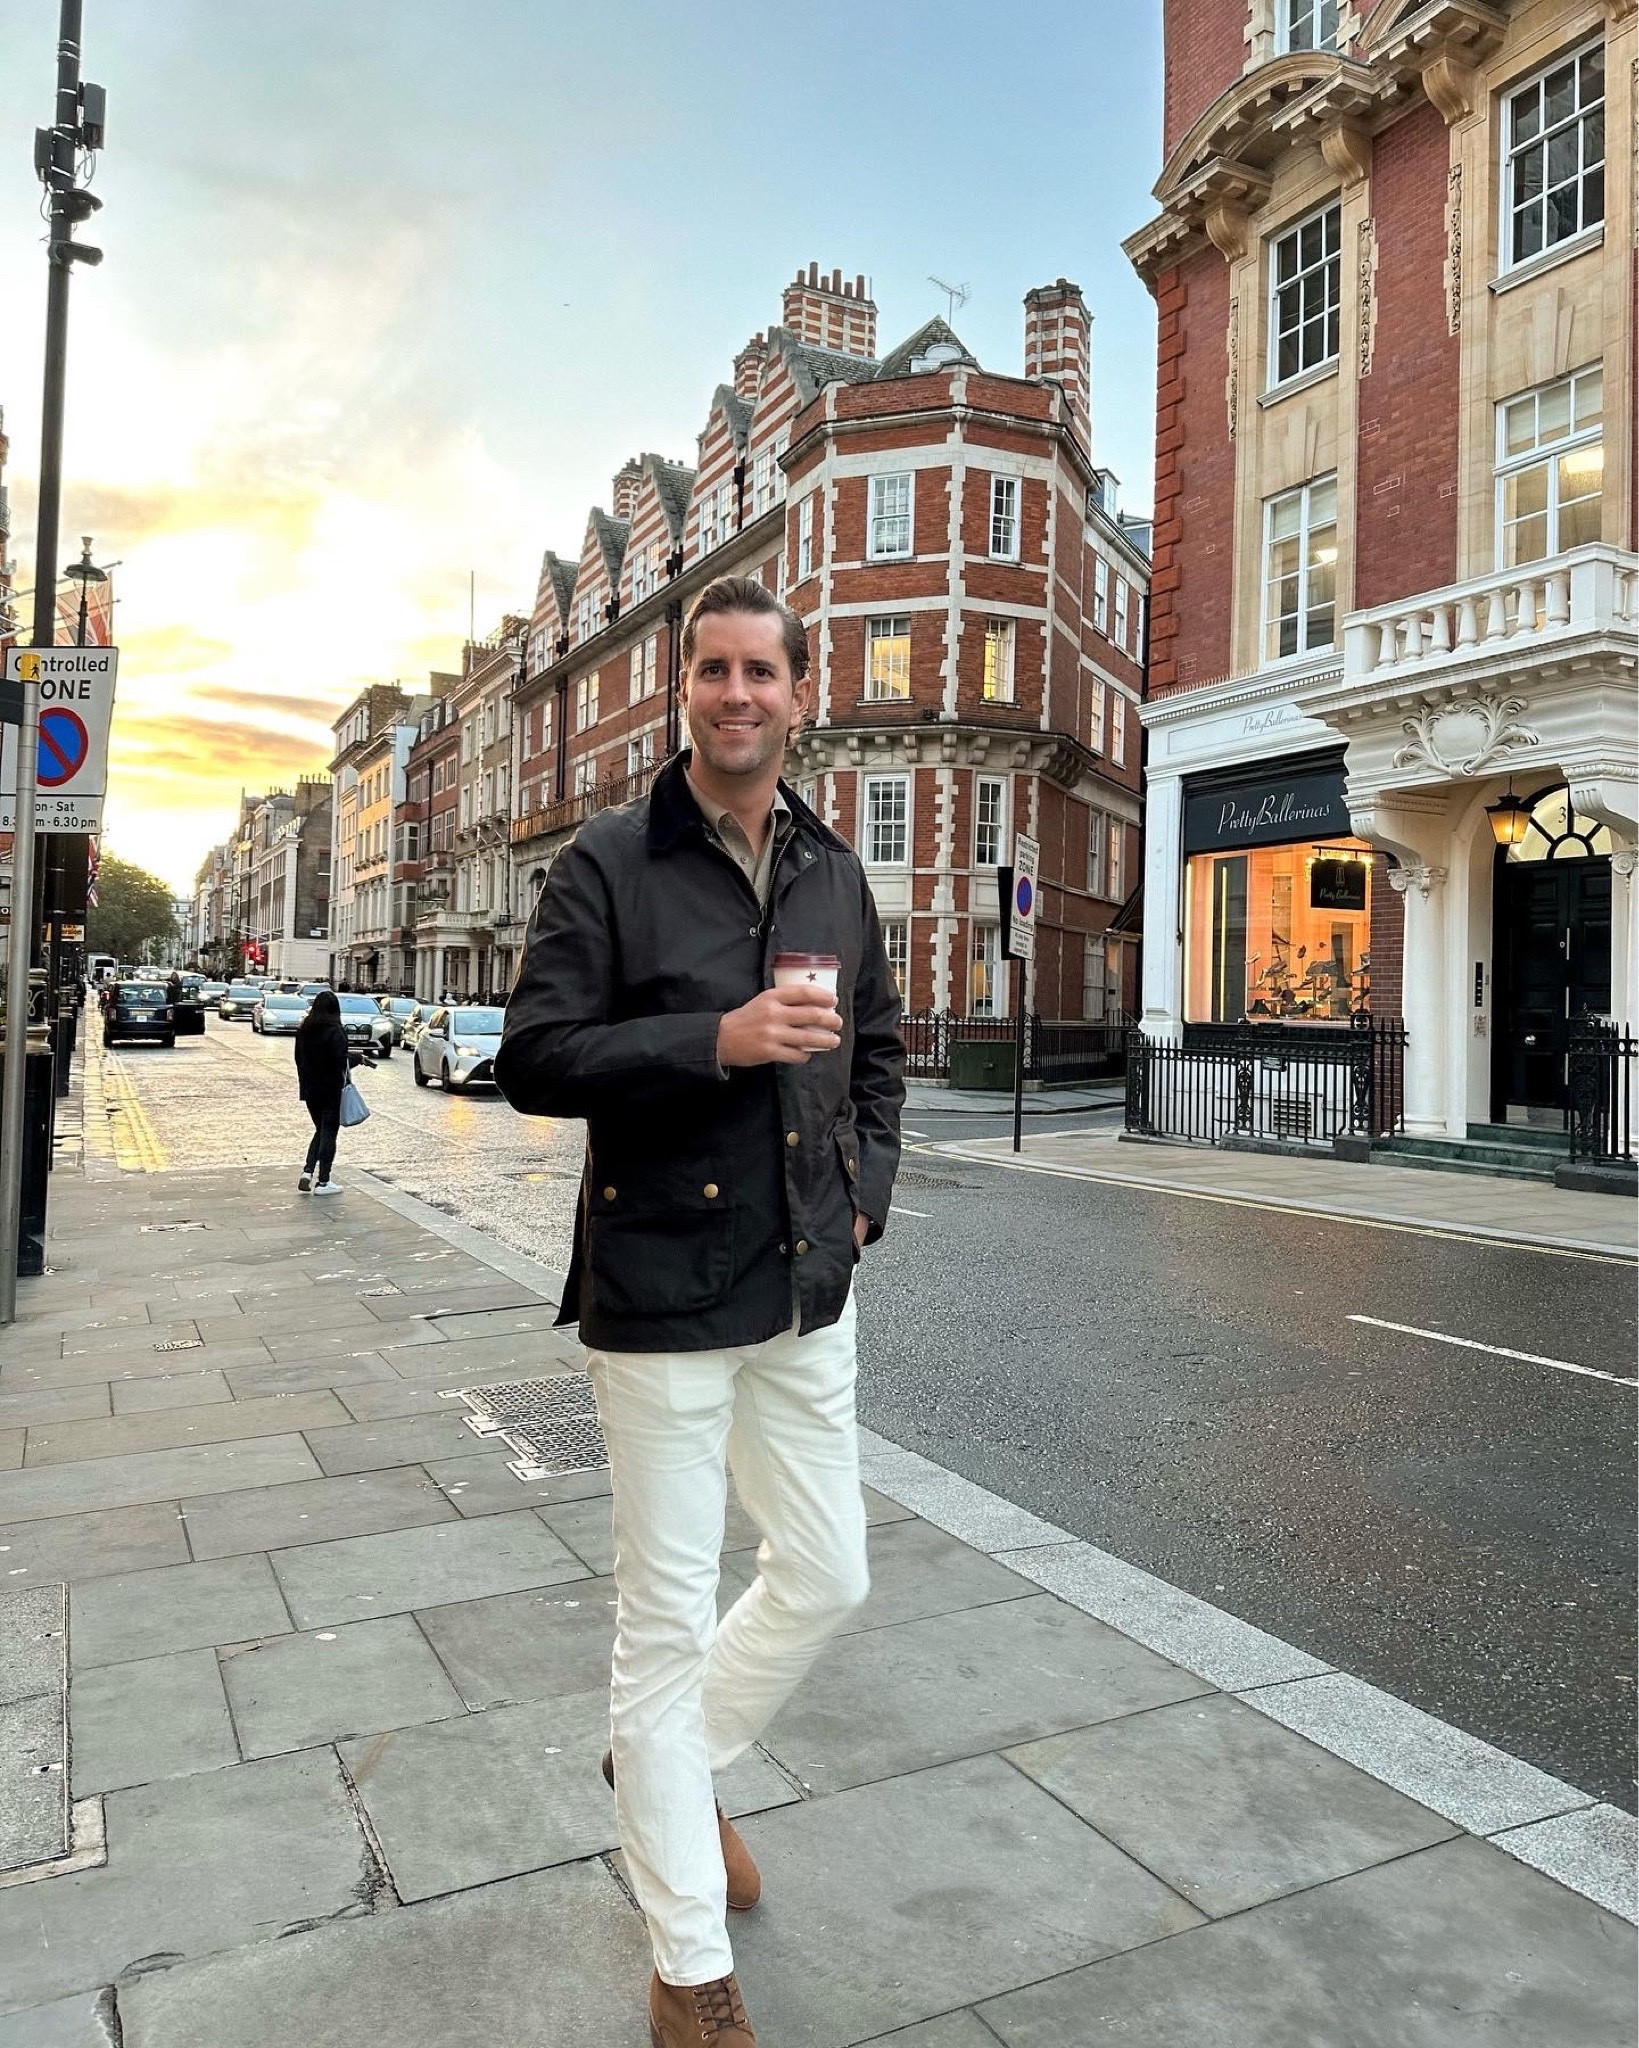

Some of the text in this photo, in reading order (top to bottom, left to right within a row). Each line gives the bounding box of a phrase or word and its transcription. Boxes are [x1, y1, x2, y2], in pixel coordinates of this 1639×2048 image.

[40, 679, 92, 700] ONE
[35, 803, 48, 812] on
[56, 801, 75, 812] Sat
